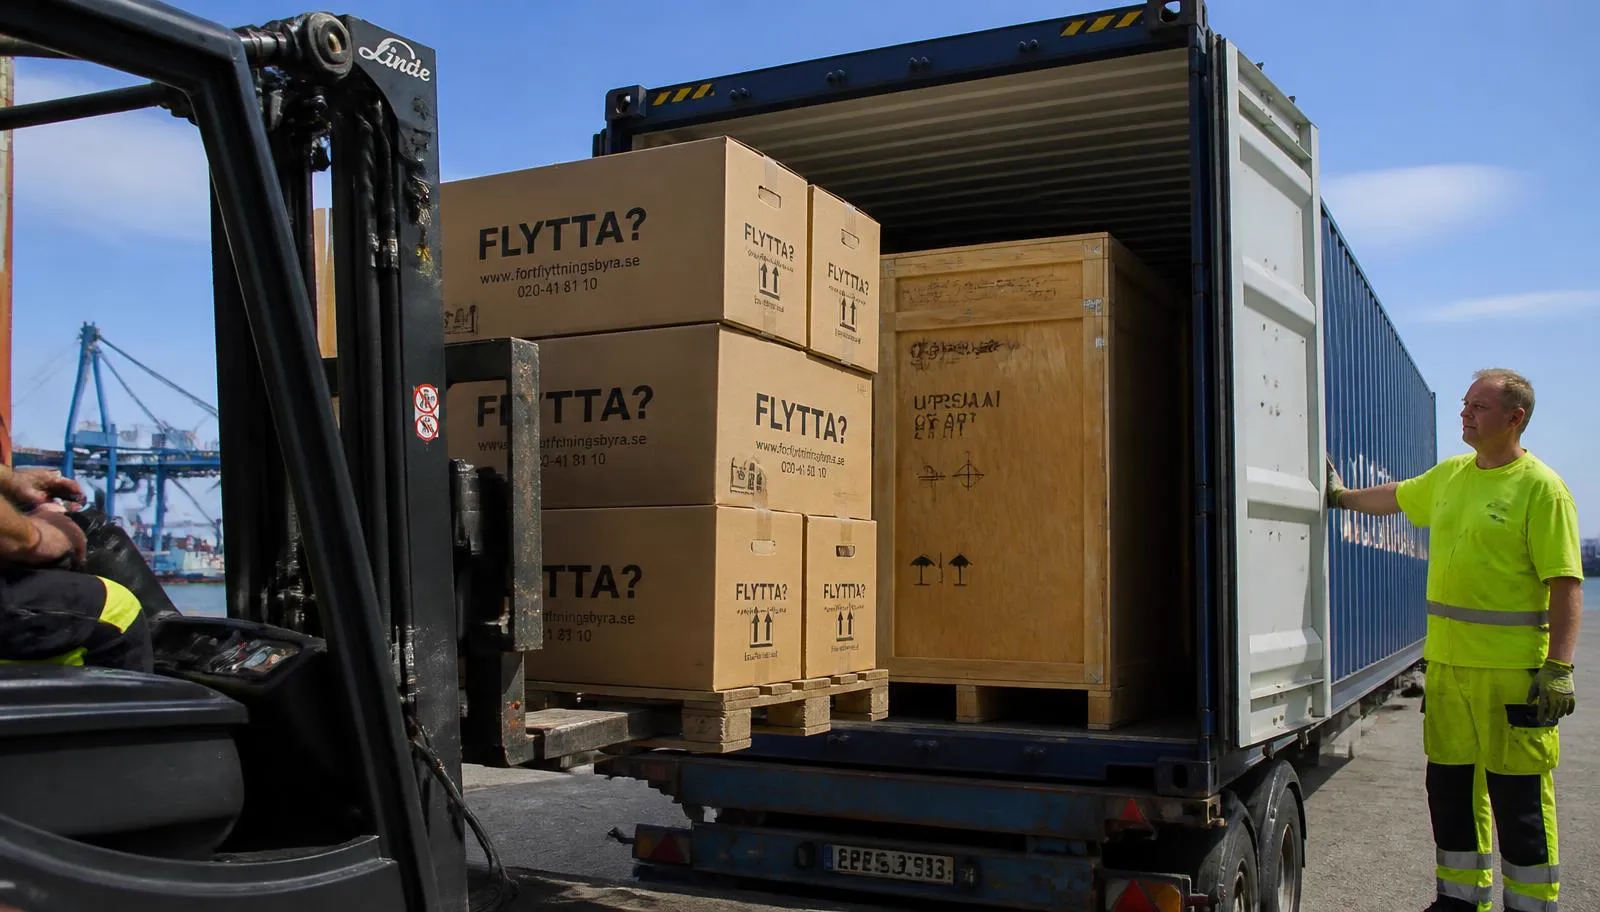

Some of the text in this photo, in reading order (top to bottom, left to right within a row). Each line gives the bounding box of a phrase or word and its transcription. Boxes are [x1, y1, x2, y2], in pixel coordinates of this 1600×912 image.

[358, 37, 431, 81] Linde
[479, 207, 647, 260] FLYTTA?
[744, 222, 795, 262] FLYTTA?
[518, 278, 598, 298] 020-41 81 10
[828, 262, 869, 296] FLYTTA?
[755, 392, 847, 444] FLYTTA?
[591, 452, 606, 465] 10
[736, 583, 788, 600] FLYTTA?
[823, 583, 866, 599] FLYTTA?
[576, 629, 592, 642] 10
